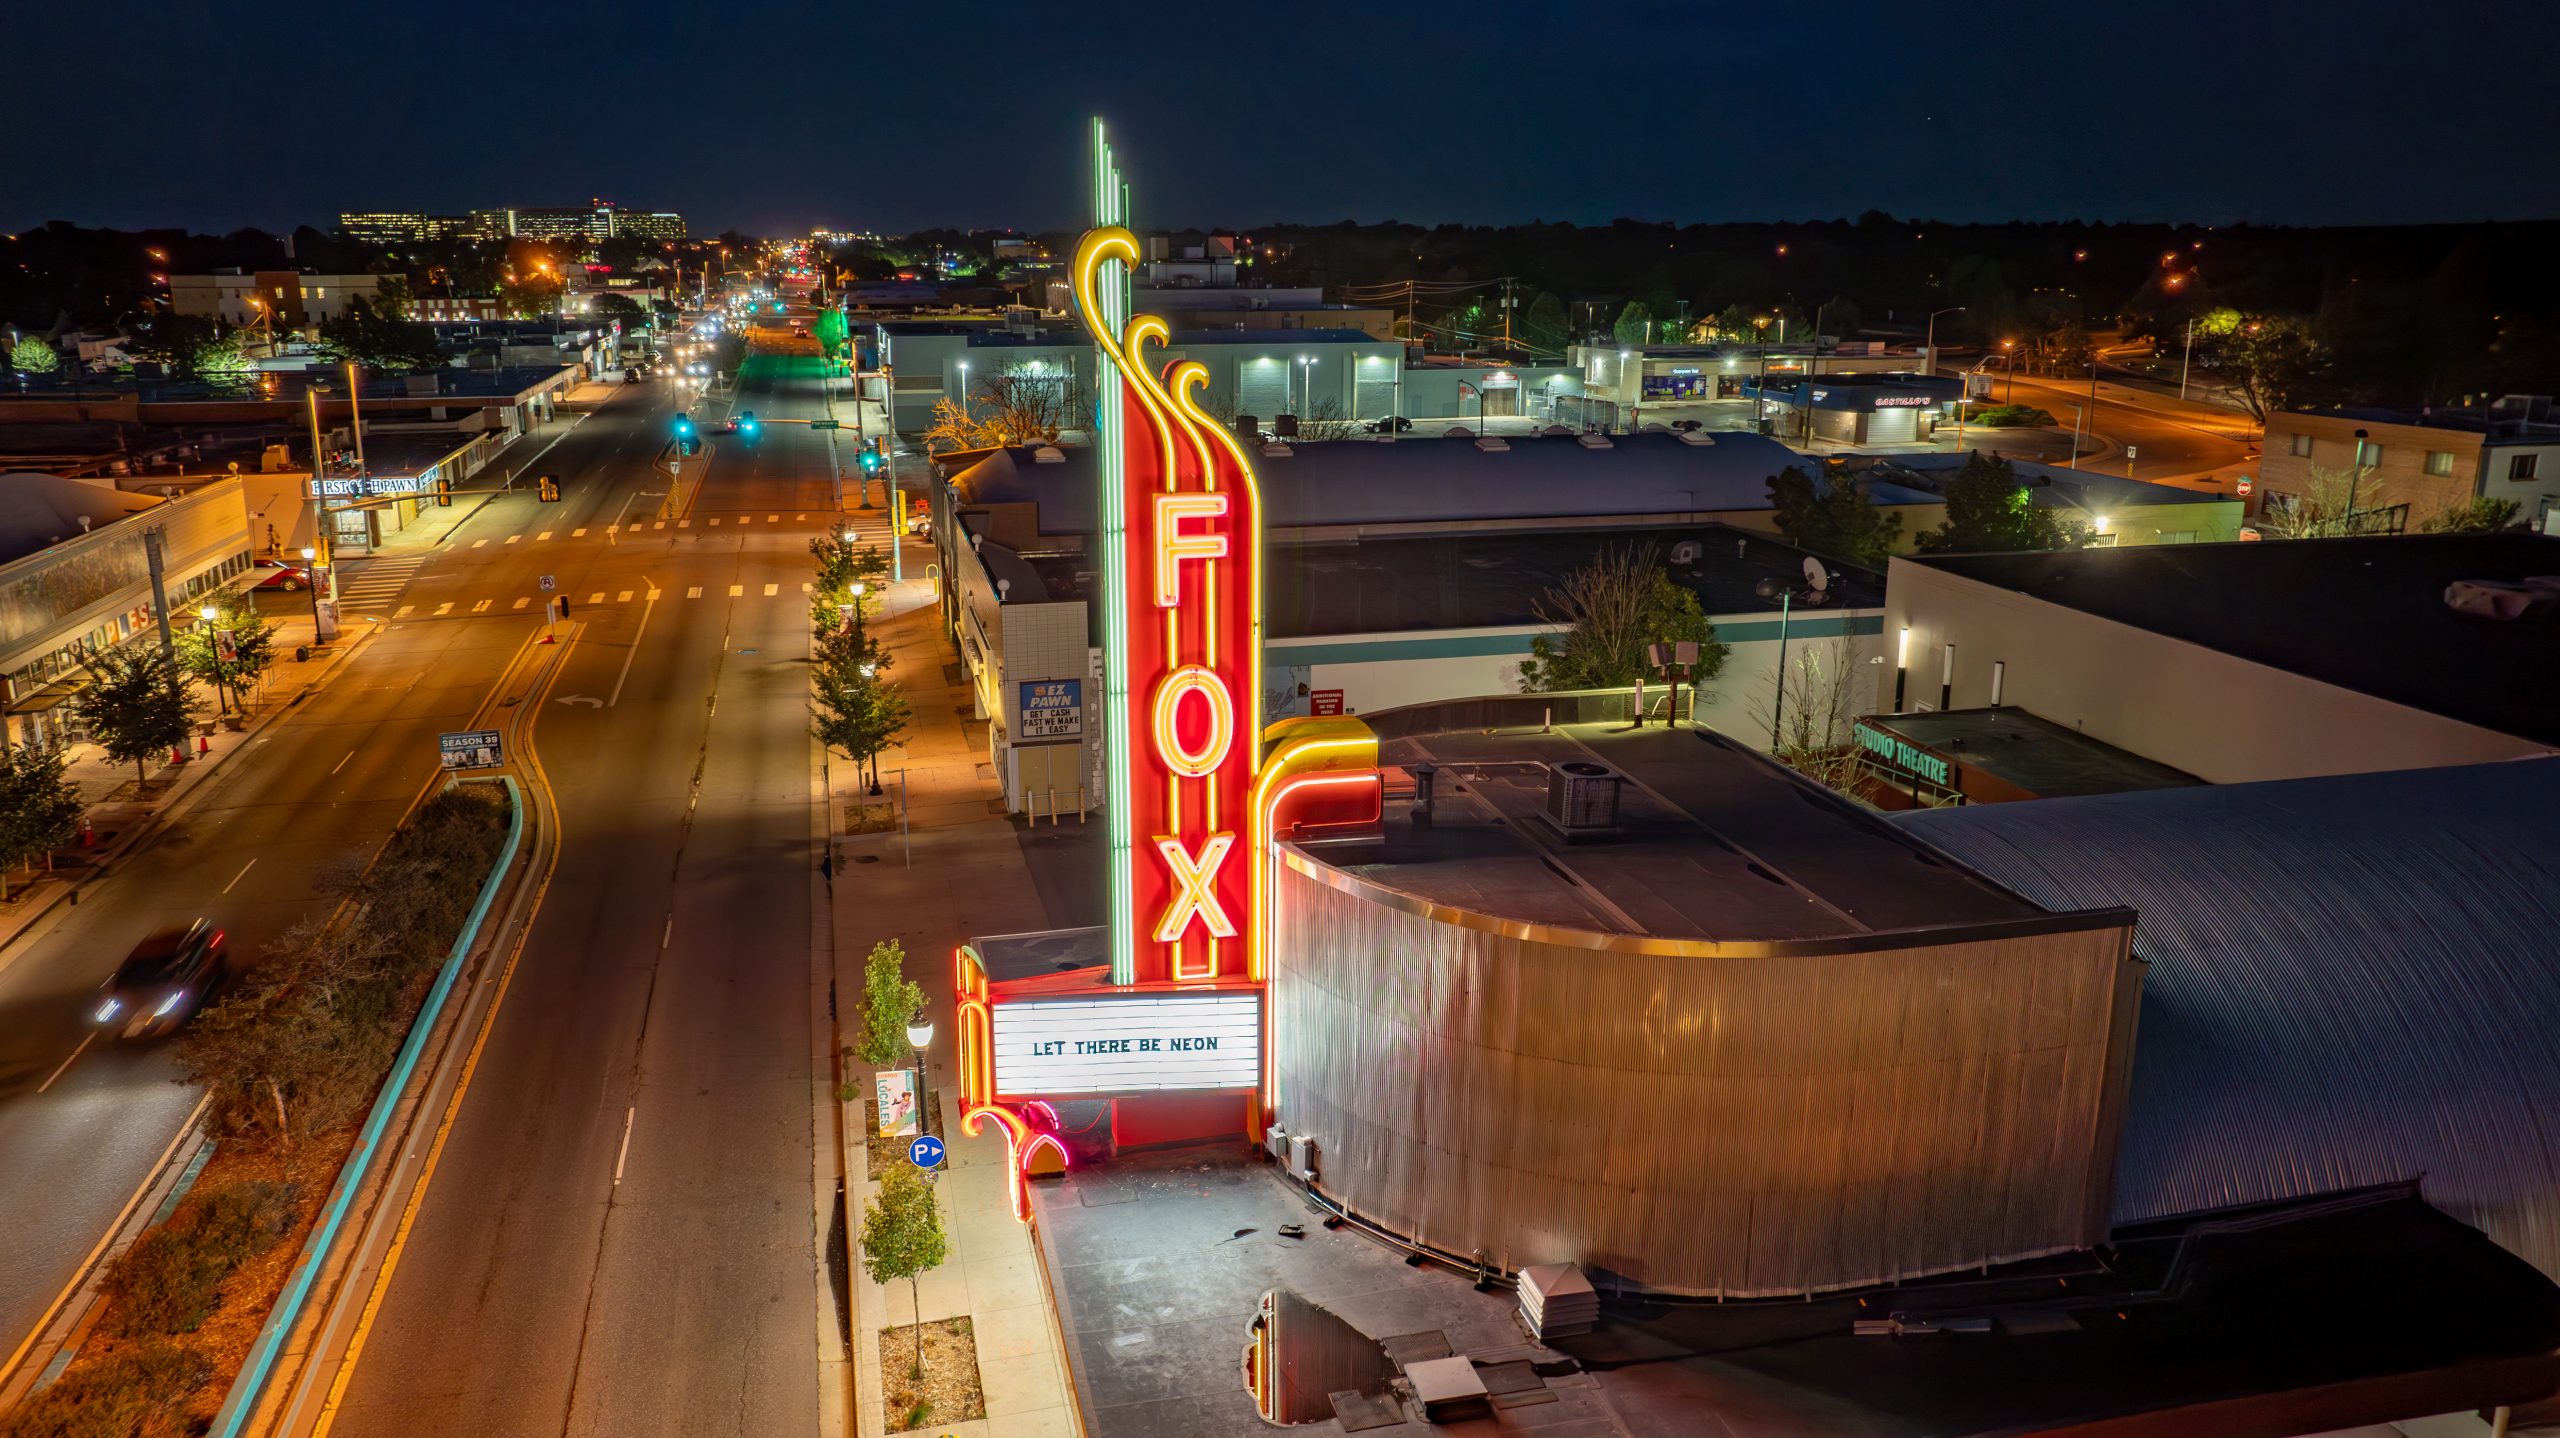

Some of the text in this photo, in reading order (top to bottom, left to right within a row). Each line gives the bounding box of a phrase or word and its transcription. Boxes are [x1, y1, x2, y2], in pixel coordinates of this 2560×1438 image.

[1875, 397, 1930, 406] CASTILLO'S
[312, 481, 346, 494] FRST
[383, 479, 416, 492] PAWN
[1048, 685, 1065, 695] EZ
[1030, 696, 1071, 707] PAWN
[1051, 709, 1070, 717] CASH
[1152, 493, 1239, 943] FOX
[1024, 719, 1043, 727] FAST
[1058, 716, 1079, 724] MAKE
[1050, 725, 1069, 733] EASY
[442, 736, 498, 747] SEASON 39
[1854, 722, 1948, 785] STUDIO THEATRE
[1033, 1037, 1218, 1056] LET THERE BE NEON
[877, 1080, 890, 1127] LOCALES
[914, 1144, 929, 1162] P
